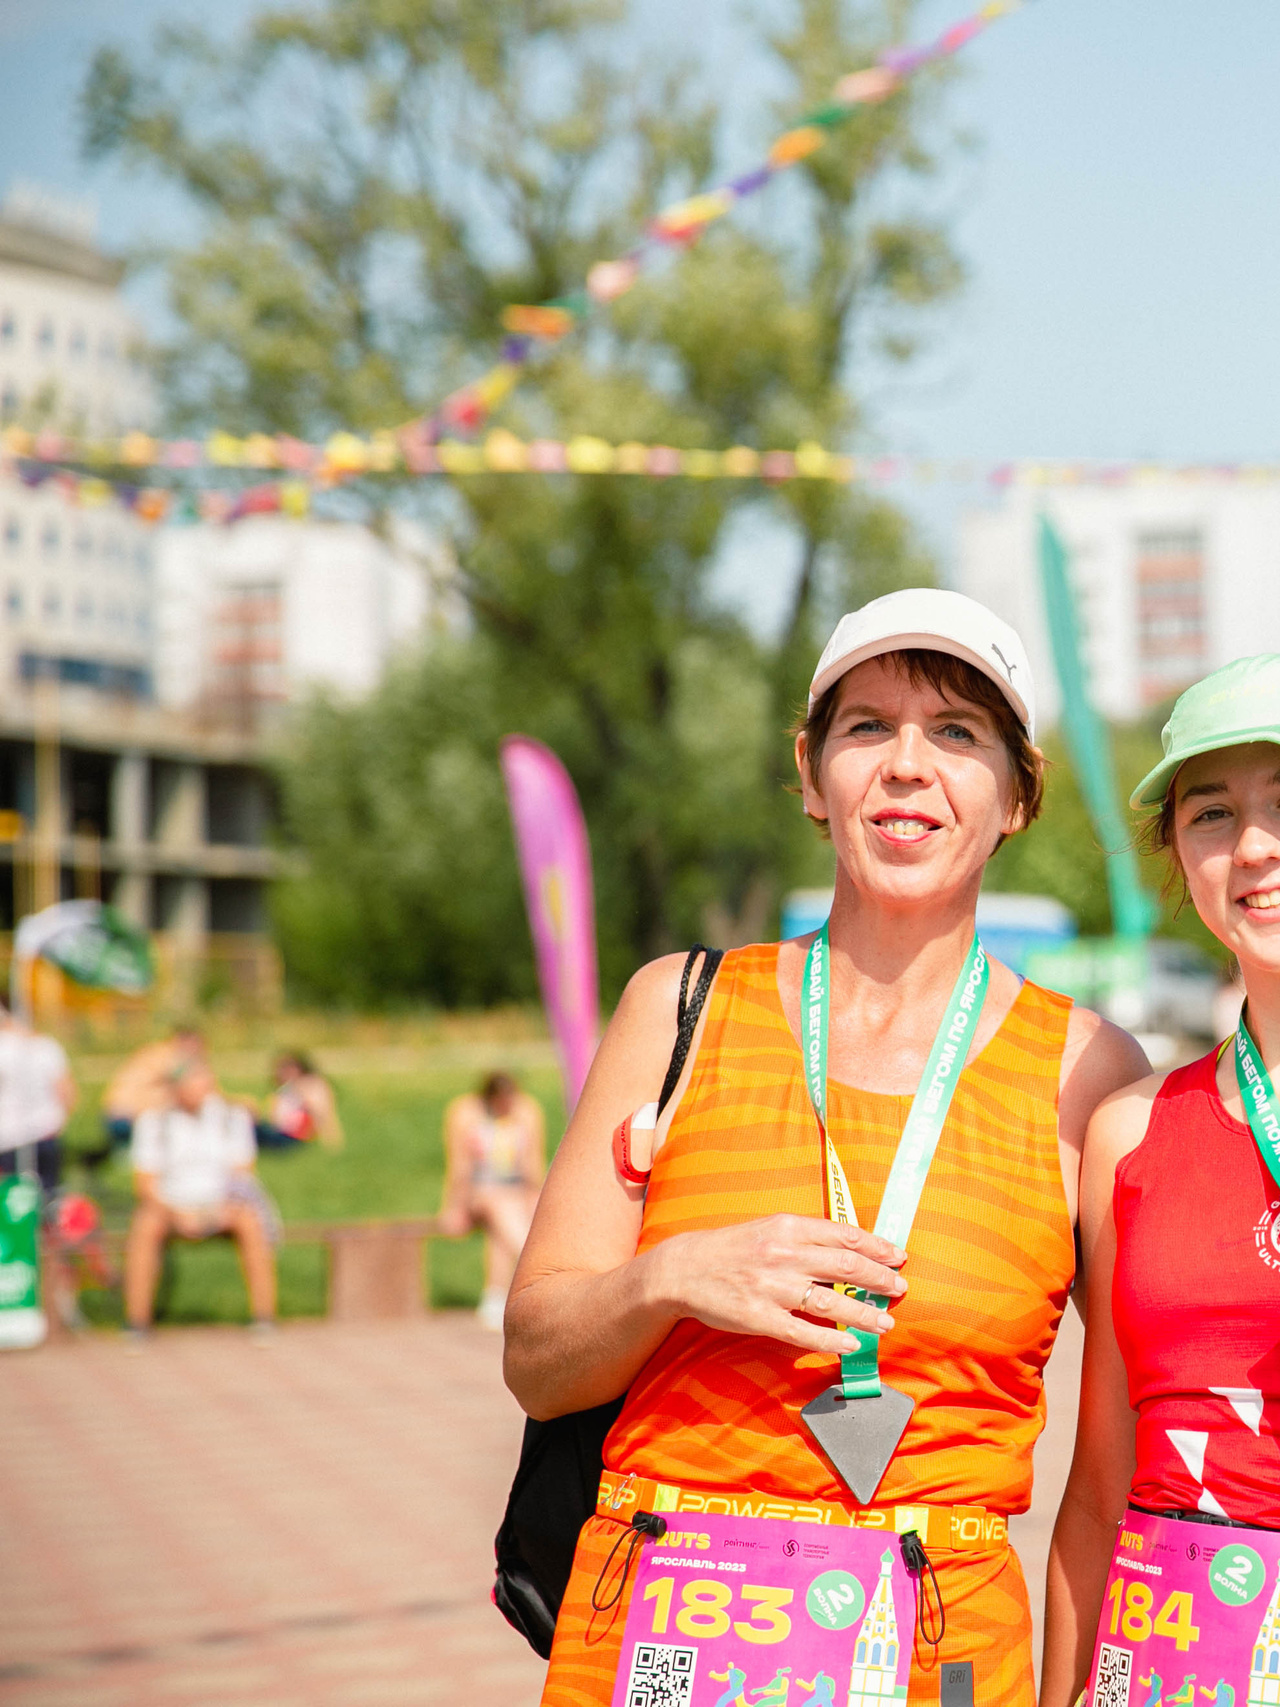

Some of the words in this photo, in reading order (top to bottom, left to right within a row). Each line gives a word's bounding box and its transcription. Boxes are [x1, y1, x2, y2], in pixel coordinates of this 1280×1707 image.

[809, 937, 824, 1002] ДАВАЙ
[808, 1005, 822, 1076] БЕГОМ
[927, 1038, 958, 1114] БЕГОМ
[949, 1012, 968, 1044] ПО
[962, 941, 986, 1011] ЯРОСЛ
[811, 1079, 823, 1108] ПО
[1241, 1051, 1269, 1112] БЕГОМ
[1261, 1110, 1280, 1142] ПО
[831, 1162, 847, 1224] SERIE
[655, 1531, 711, 1550] RUTS
[951, 1517, 1008, 1541] POWE
[1120, 1530, 1144, 1551] RUTS
[651, 1556, 716, 1570] ЯРОСЛАВЛЬ
[717, 1562, 747, 1573] 2023
[1115, 1556, 1145, 1572] ЯРОСЛАВЛЬ
[1145, 1564, 1162, 1576] 2023
[1225, 1555, 1253, 1585] 2
[826, 1583, 855, 1612] 2
[1214, 1572, 1248, 1600] ВОЛНА
[643, 1576, 794, 1645] 183
[812, 1587, 838, 1626] ВОЛНА
[1108, 1577, 1200, 1652] 184
